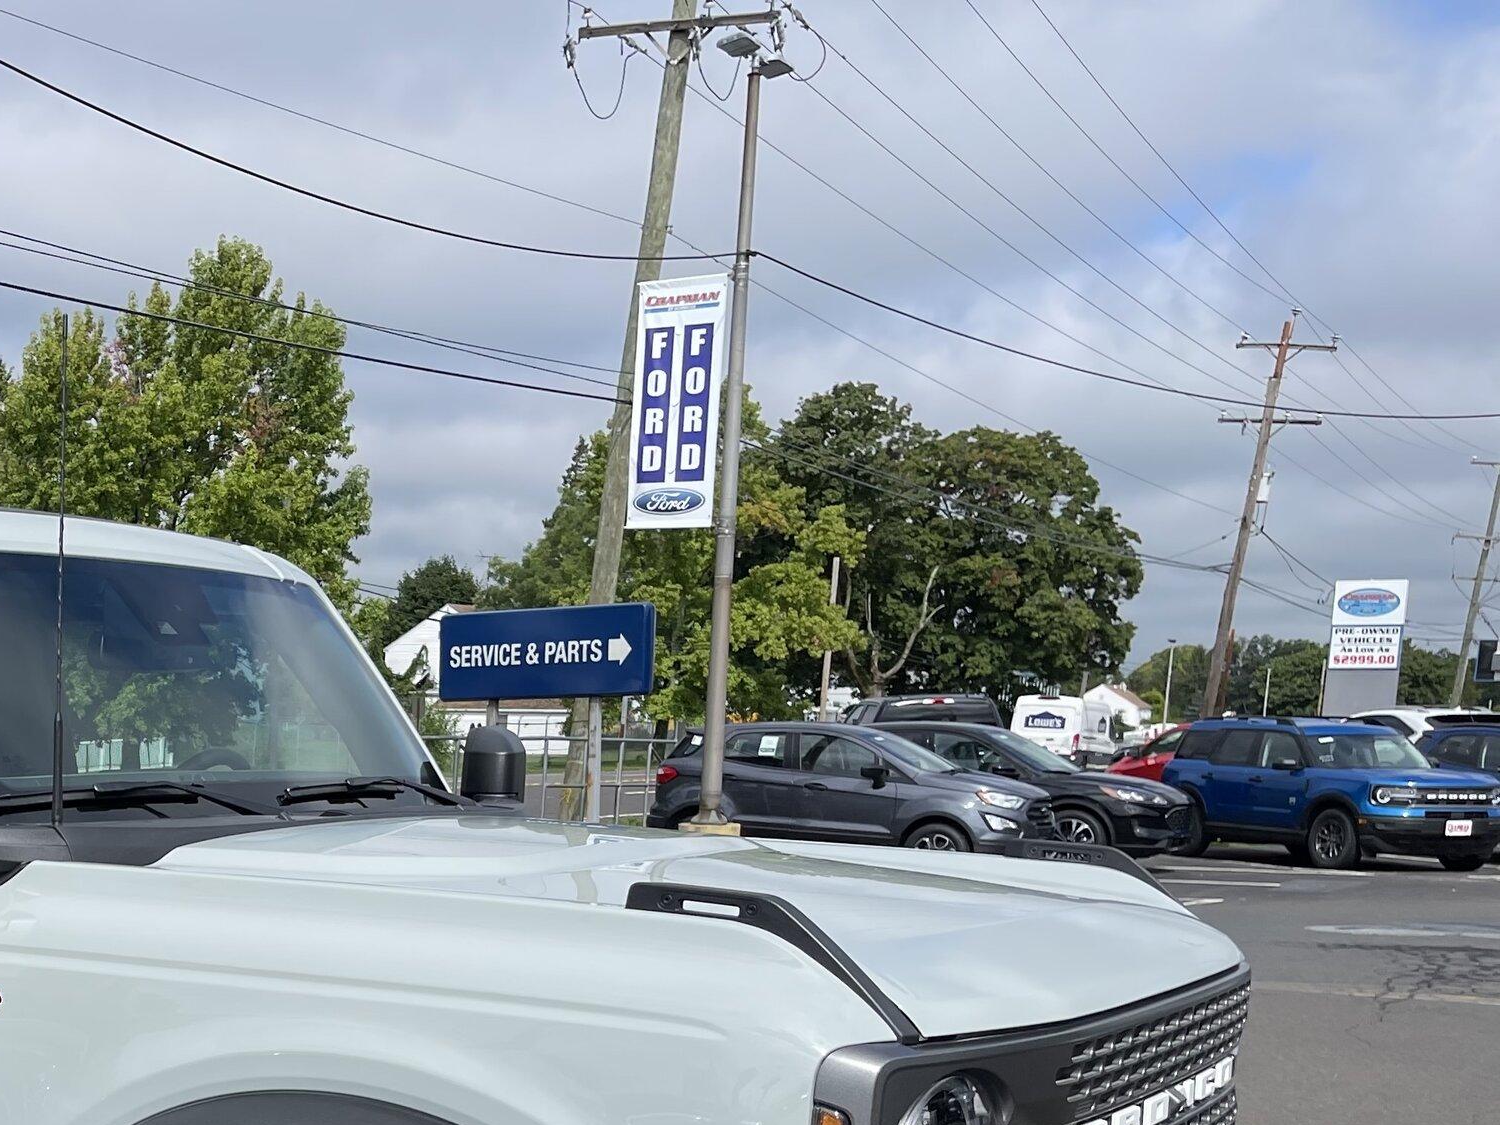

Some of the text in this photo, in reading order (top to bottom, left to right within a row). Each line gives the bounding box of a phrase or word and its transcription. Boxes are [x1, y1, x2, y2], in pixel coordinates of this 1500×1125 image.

[641, 331, 668, 473] FORD
[680, 327, 707, 471] FORD
[646, 490, 691, 512] Ford
[1340, 636, 1392, 644] VEHICLES
[449, 638, 603, 669] SERVICE & PARTS
[1333, 654, 1395, 665] $2999.00
